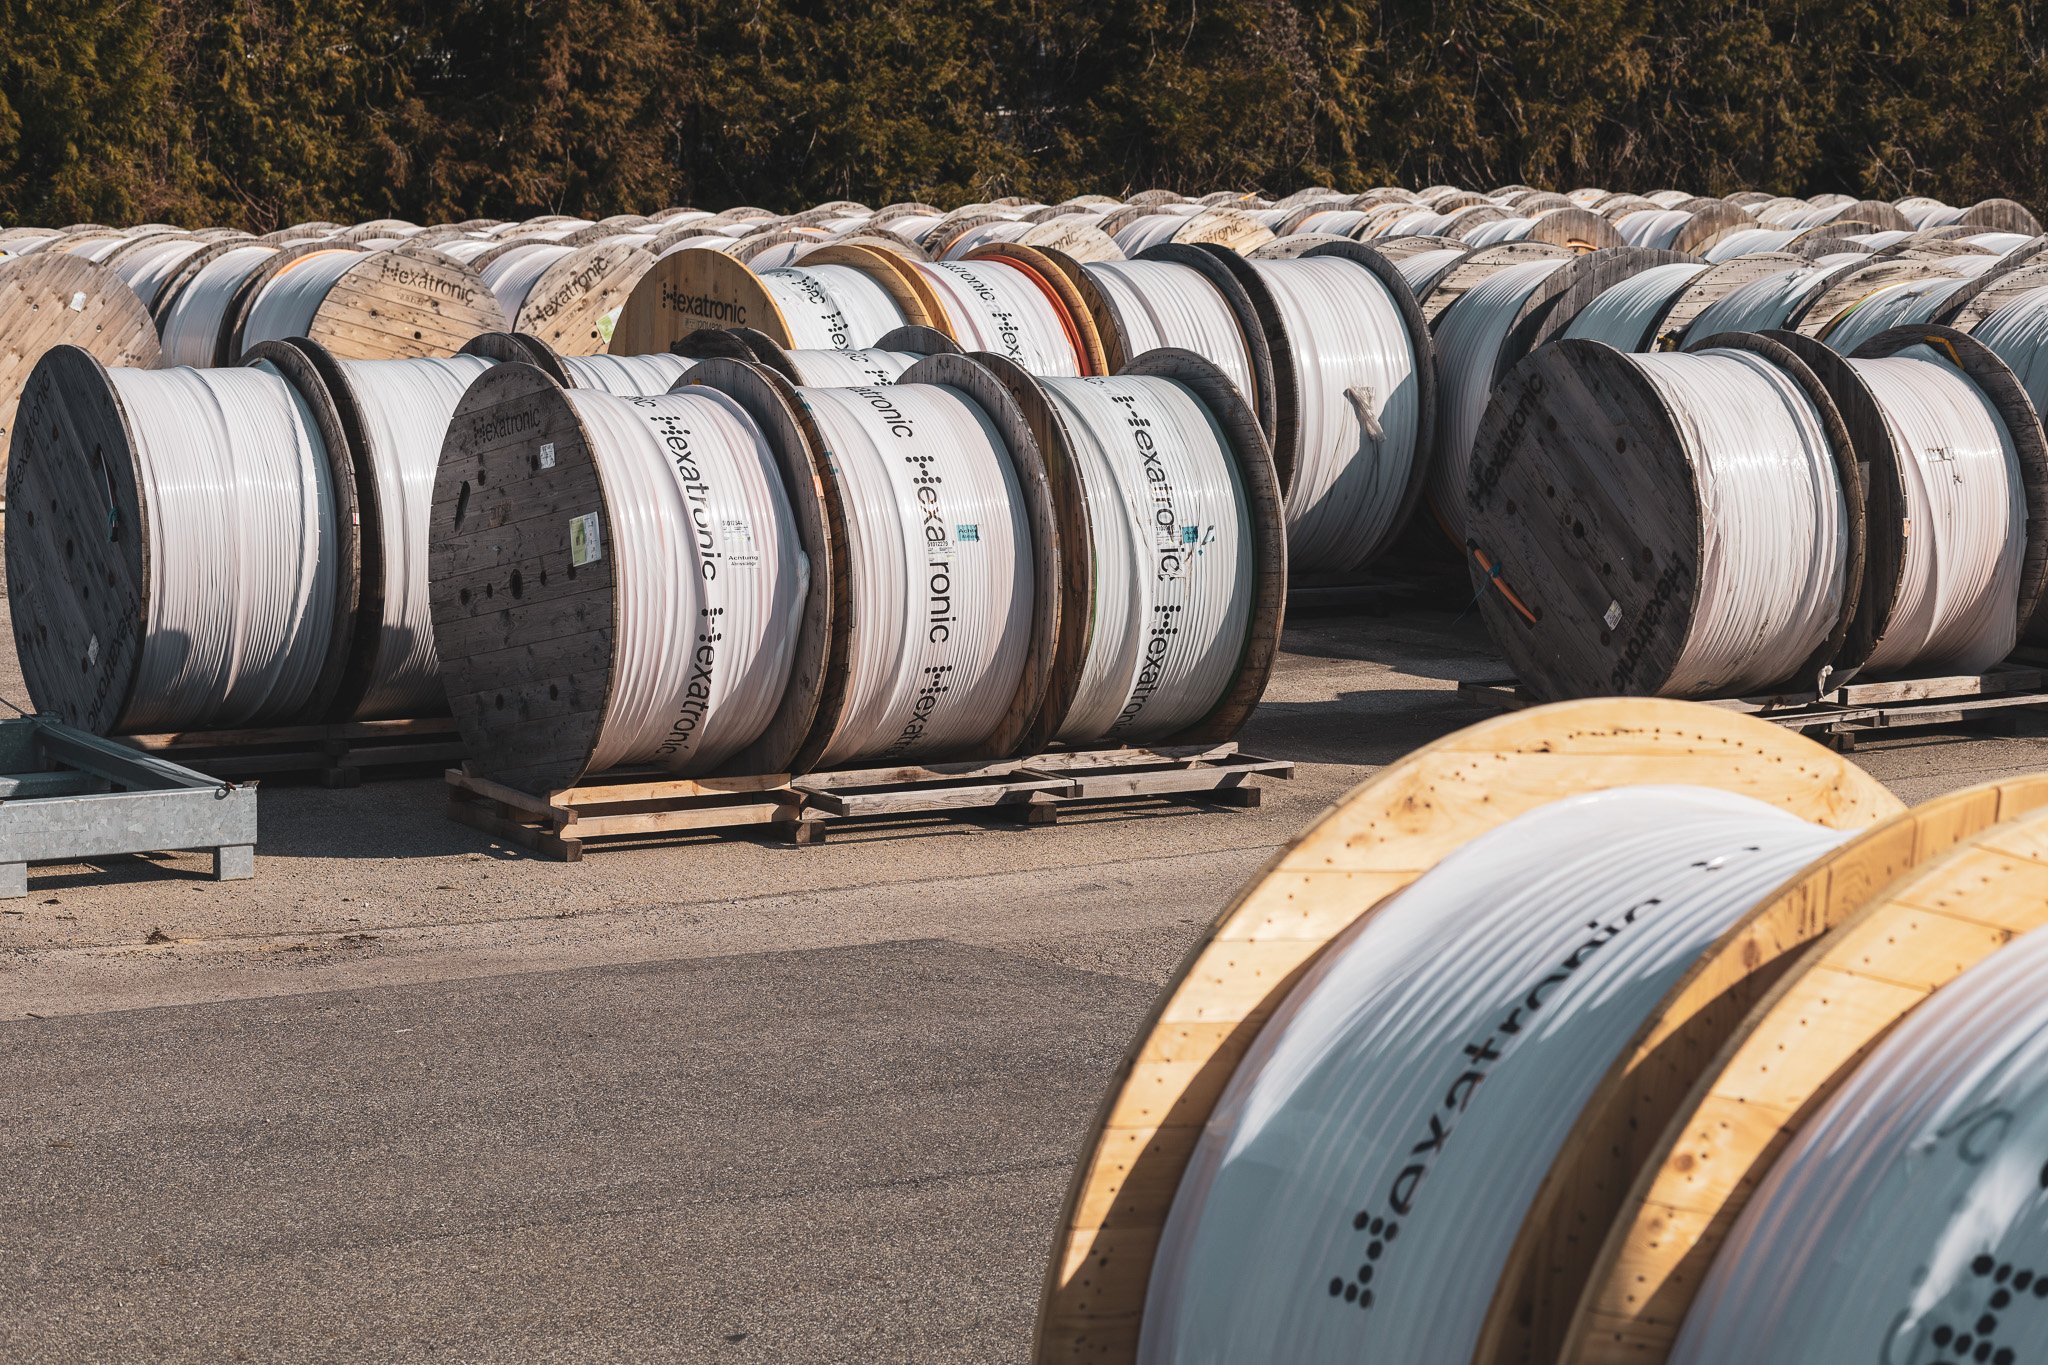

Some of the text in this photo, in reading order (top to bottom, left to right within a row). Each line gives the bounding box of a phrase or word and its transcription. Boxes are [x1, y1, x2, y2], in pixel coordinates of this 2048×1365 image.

[381, 258, 477, 303] Hexatronic
[520, 255, 609, 332] Hexatronic
[662, 282, 747, 325] Hexatronic
[473, 404, 541, 447] Hexatronic
[650, 416, 722, 581] Hexatronic
